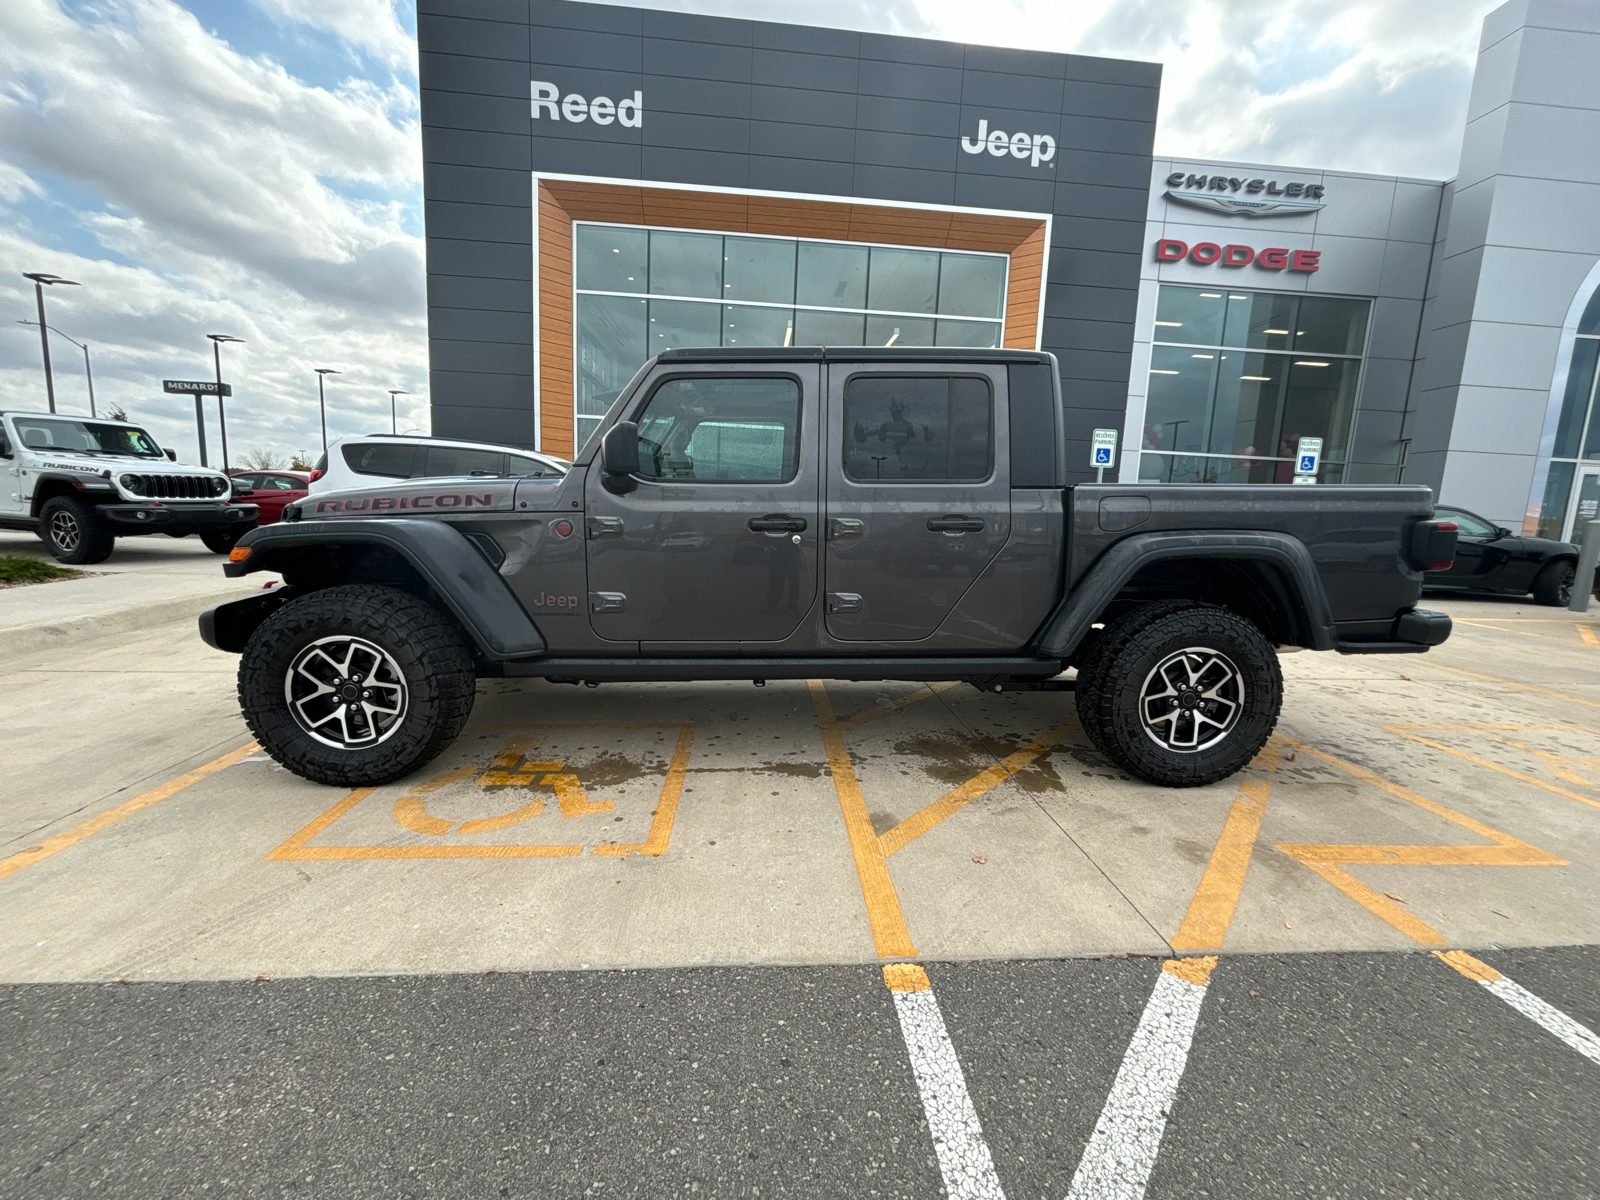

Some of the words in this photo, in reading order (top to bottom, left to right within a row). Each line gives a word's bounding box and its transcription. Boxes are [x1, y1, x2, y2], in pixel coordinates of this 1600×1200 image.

[530, 80, 643, 129] Reed
[961, 119, 1056, 168] Jeep
[1166, 172, 1325, 198] CHRYSLER
[1157, 238, 1322, 273] DODGE
[43, 462, 99, 473] RUBICON
[316, 494, 493, 513] RUBICON
[533, 592, 579, 611] Jeep
